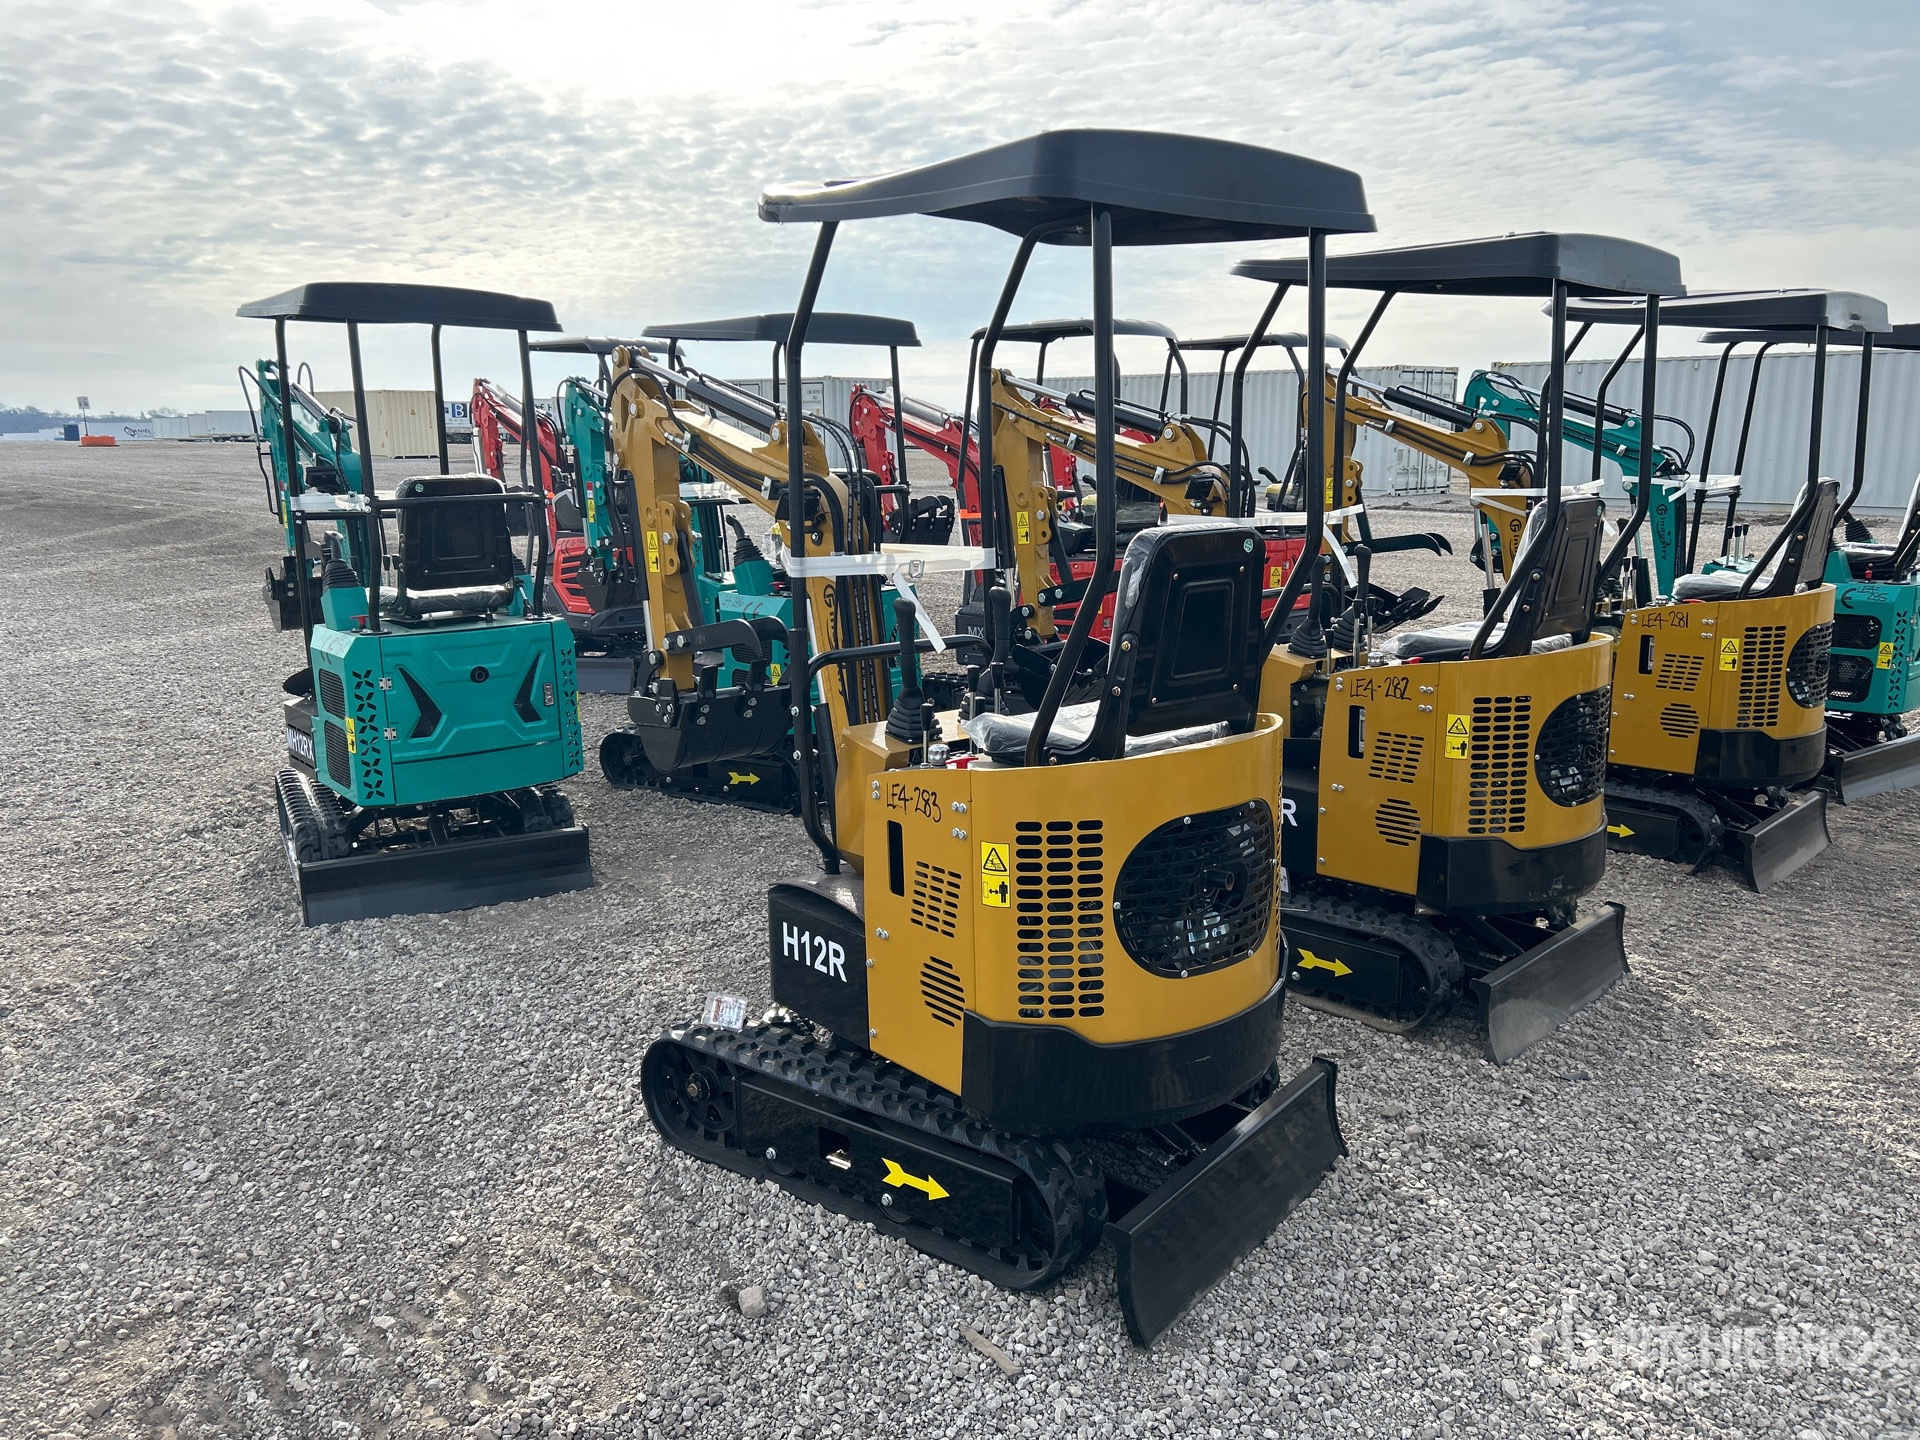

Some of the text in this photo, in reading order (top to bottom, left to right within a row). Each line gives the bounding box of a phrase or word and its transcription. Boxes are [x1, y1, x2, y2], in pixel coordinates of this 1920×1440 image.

[1641, 610, 1690, 631] LE4-281
[1349, 676, 1412, 702] LE4-282
[886, 783, 942, 823] LE4-283
[782, 921, 848, 983] H12R
